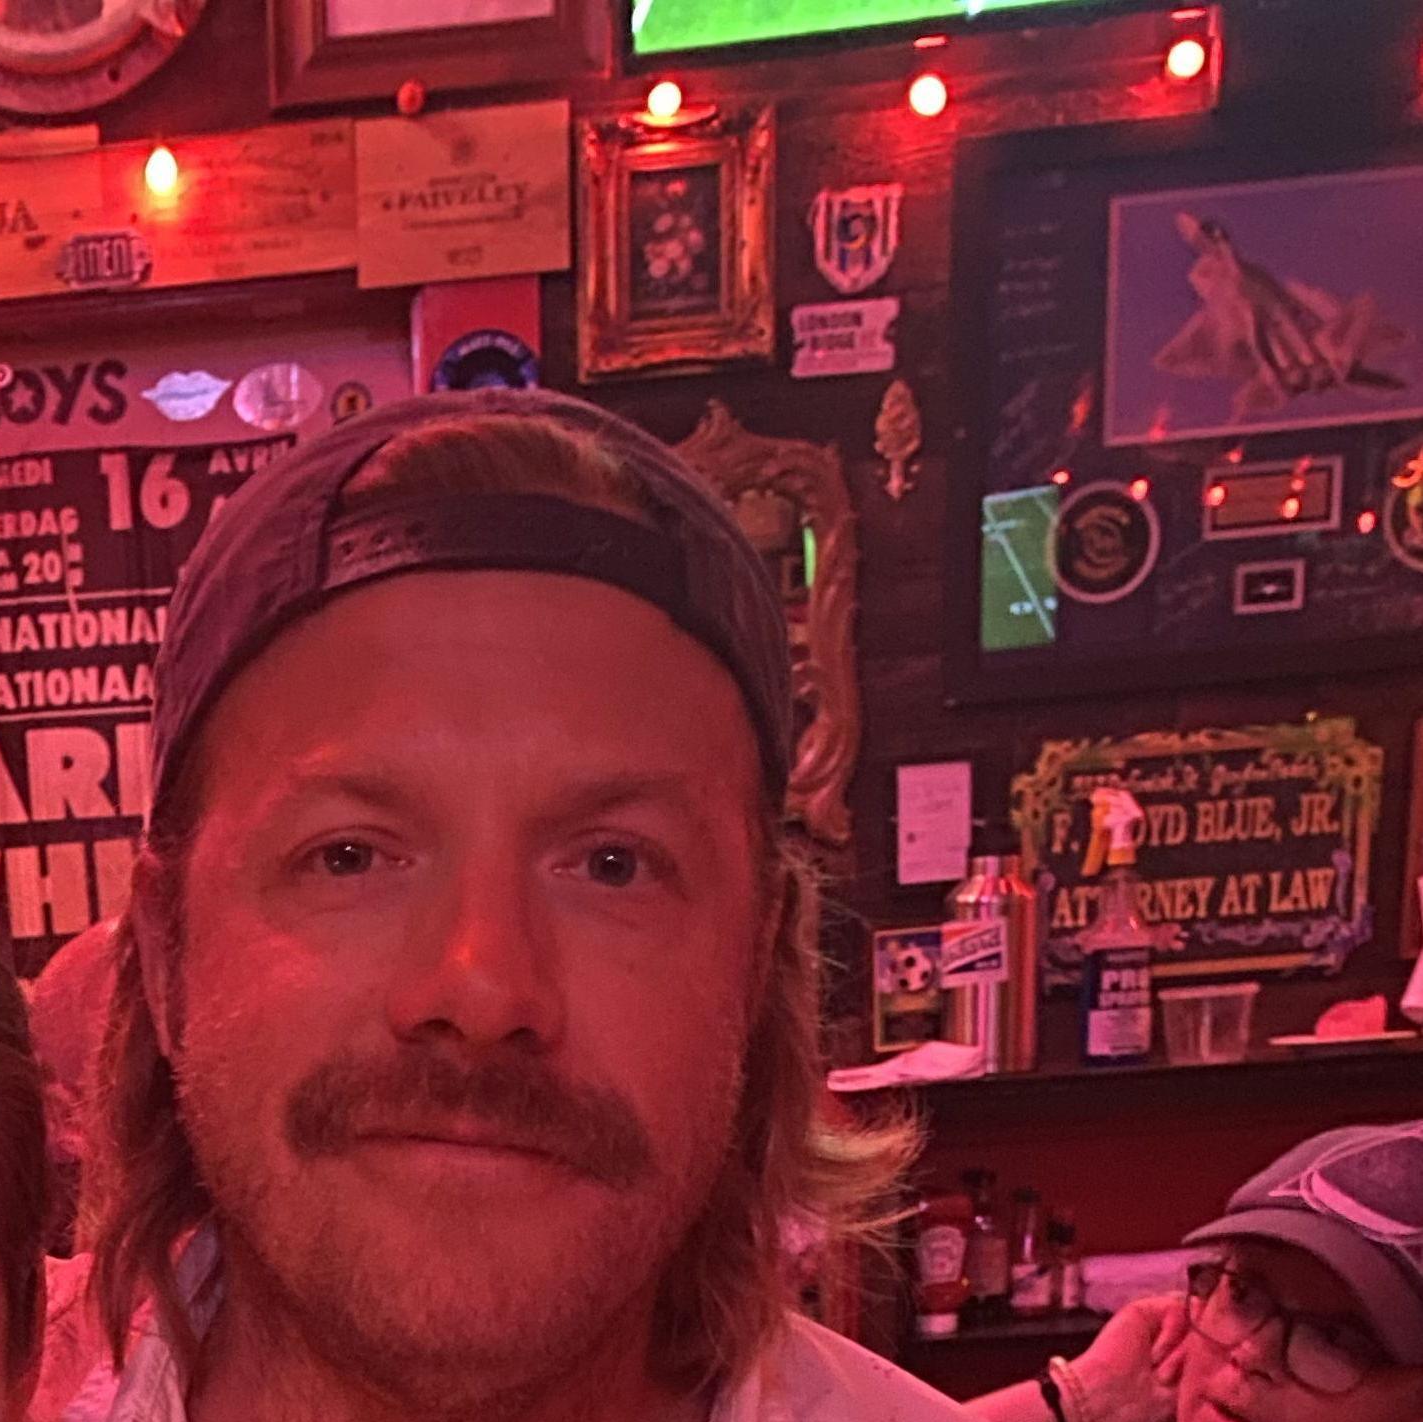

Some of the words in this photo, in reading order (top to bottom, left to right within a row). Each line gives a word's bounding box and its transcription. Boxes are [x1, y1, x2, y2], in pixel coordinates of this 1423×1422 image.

[99, 452, 191, 532] 16
[22, 550, 63, 585] 20
[1195, 797, 1283, 843] BLUE,
[1291, 792, 1340, 836] JR.
[1219, 873, 1265, 917] AT
[1268, 868, 1335, 913] LAW
